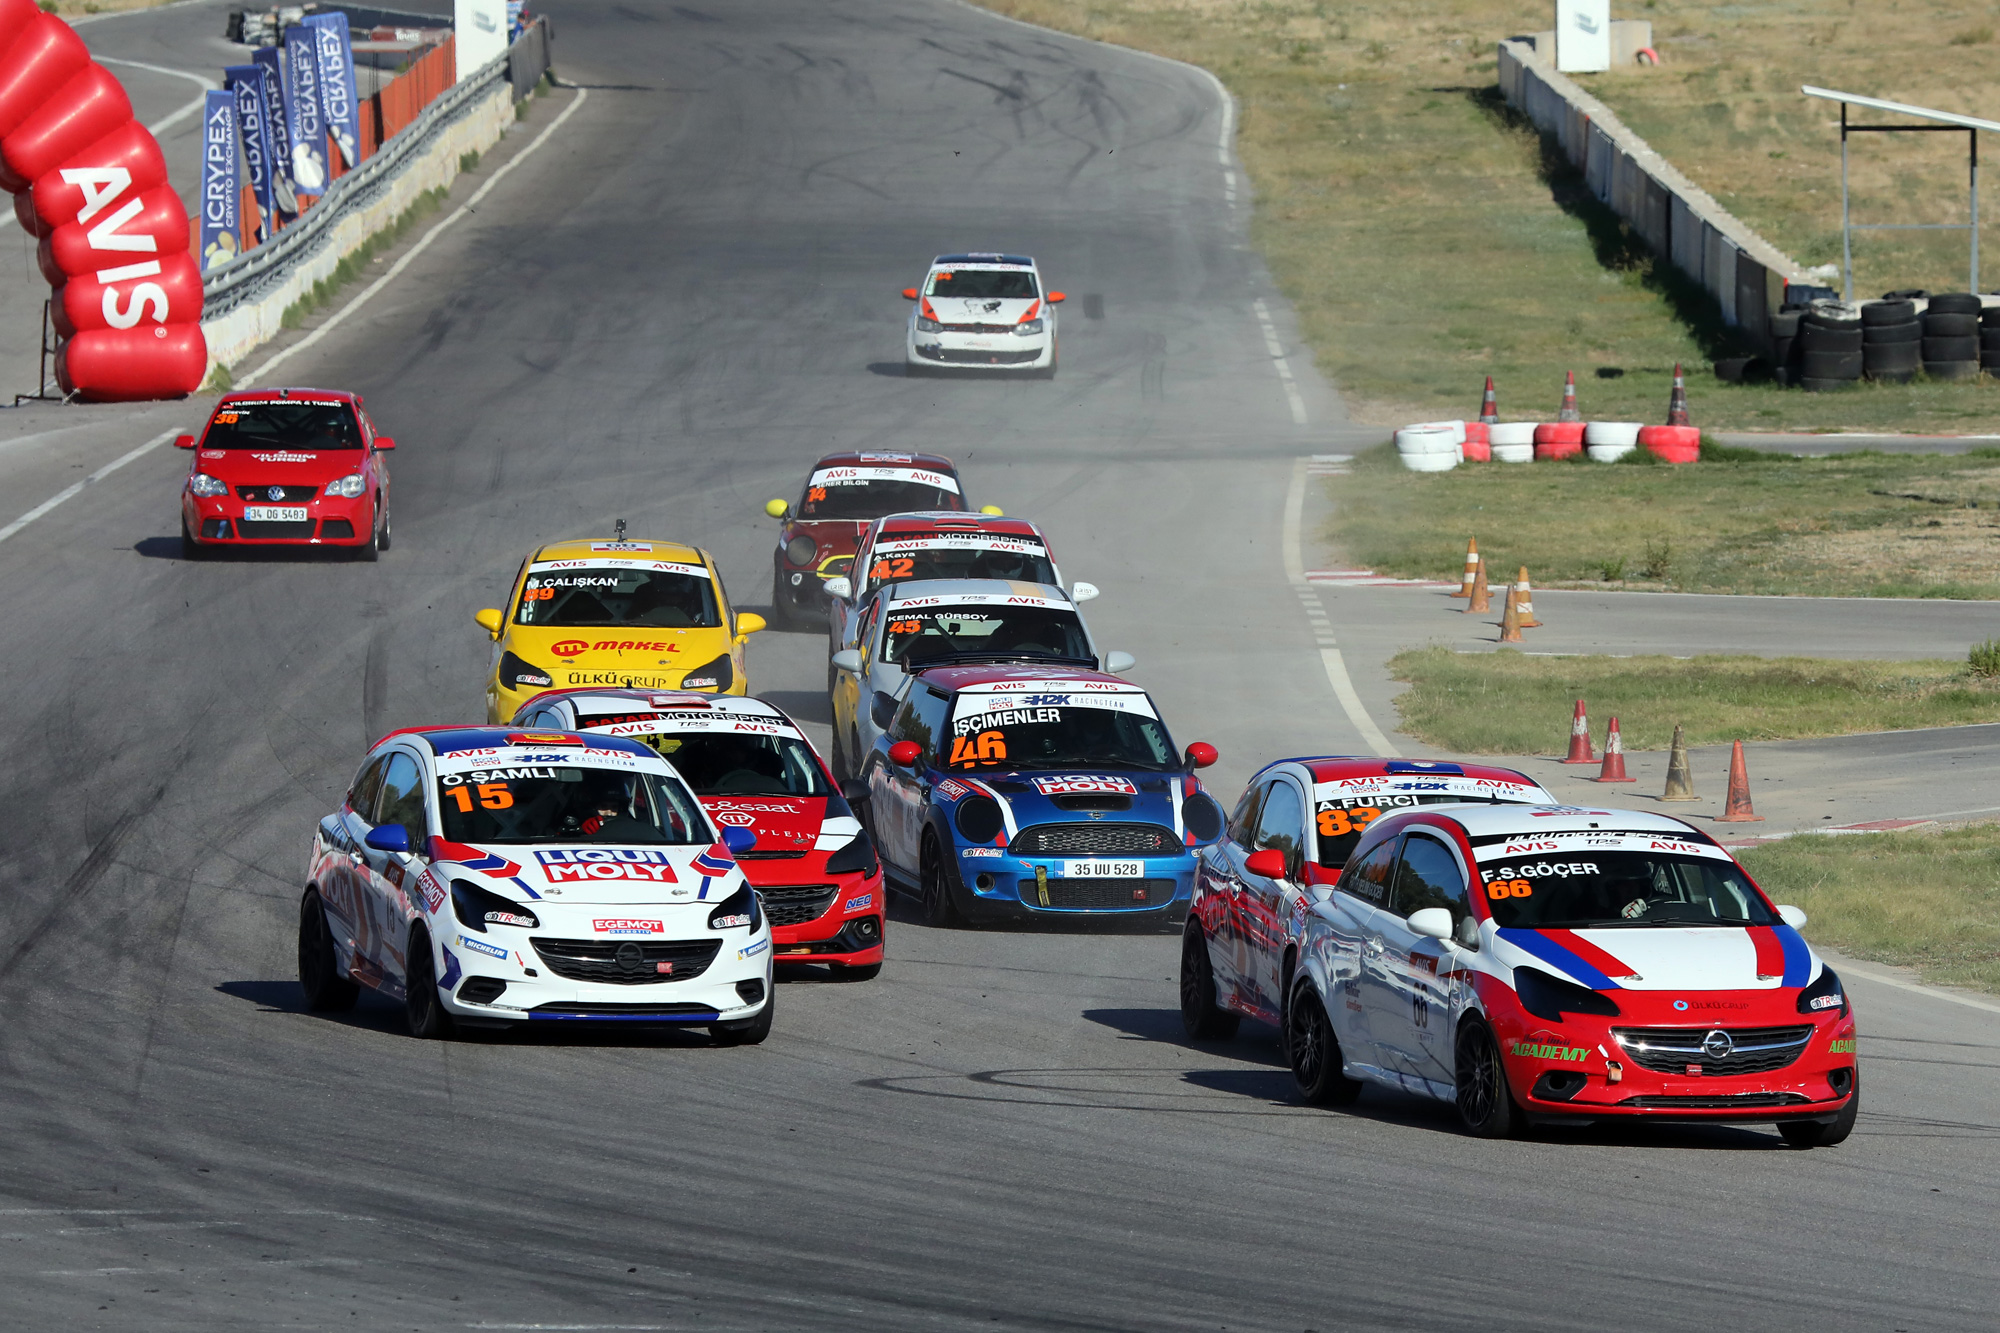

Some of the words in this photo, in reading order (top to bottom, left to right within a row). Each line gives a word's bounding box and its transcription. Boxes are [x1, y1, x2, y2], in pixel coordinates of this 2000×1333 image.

[225, 106, 234, 175] EXCHANGE
[207, 106, 226, 228] ICRYPEX
[225, 178, 234, 228] CRYPTO
[59, 167, 169, 329] AVIS
[214, 413, 239, 424] 36
[826, 468, 857, 479] AVIS
[911, 472, 941, 484] AVIS
[808, 487, 826, 502] 14
[251, 509, 262, 519] 34
[893, 541, 929, 549] AVIS
[990, 543, 1025, 551] AVIS
[873, 552, 916, 561] A.Kaya
[652, 563, 690, 573] AVIS
[869, 558, 915, 580] 42
[526, 577, 619, 589] M.ÇALIŞKAN
[523, 588, 554, 602] 89
[901, 597, 940, 607] AVIS
[1007, 597, 1046, 606] AVIS
[887, 613, 932, 622] KEMAL
[934, 612, 989, 620] GÜRSOY
[889, 620, 921, 634] 45
[592, 640, 681, 652] MAKEL
[992, 682, 1026, 691] AVIS
[1084, 683, 1118, 691] AVIS
[989, 702, 1013, 710] MOLY
[1029, 694, 1072, 706] H2K
[610, 723, 656, 735] AVIS
[734, 723, 778, 734] AVIS
[447, 748, 498, 760] AVIS
[584, 748, 633, 759] AVIS
[950, 731, 1007, 769] 46
[514, 754, 570, 763] H2K
[442, 767, 557, 786] Ö.ŞAMLI
[1039, 775, 1129, 785] LIQUI
[938, 780, 966, 797] EGEMOT
[1043, 781, 1133, 793] MOLY
[1339, 776, 1390, 788] AVIS
[1476, 779, 1525, 792] AVIS
[1394, 782, 1449, 791] H2K
[445, 782, 514, 813] 15
[1318, 795, 1419, 812] A.FURCI
[1316, 808, 1383, 837] 83
[758, 828, 816, 840] PLEIN
[1505, 840, 1559, 854] AVIS
[1650, 841, 1701, 854] AVIS
[544, 851, 662, 864] LIQUI
[548, 863, 669, 881] MOLY
[1075, 863, 1091, 875] 35
[1094, 863, 1110, 875] UU
[1114, 863, 1138, 876] 528
[1480, 861, 1601, 884] F.S.GÖÇER
[417, 871, 444, 907] EGEMOT
[1487, 879, 1533, 900] 66
[846, 894, 872, 910] NEO
[594, 920, 661, 930] EGEMOT
[465, 939, 505, 957] MICHELIN
[1415, 957, 1430, 974] AVIS
[1413, 981, 1428, 1029] 66
[1510, 1042, 1592, 1062] ACADEMY
